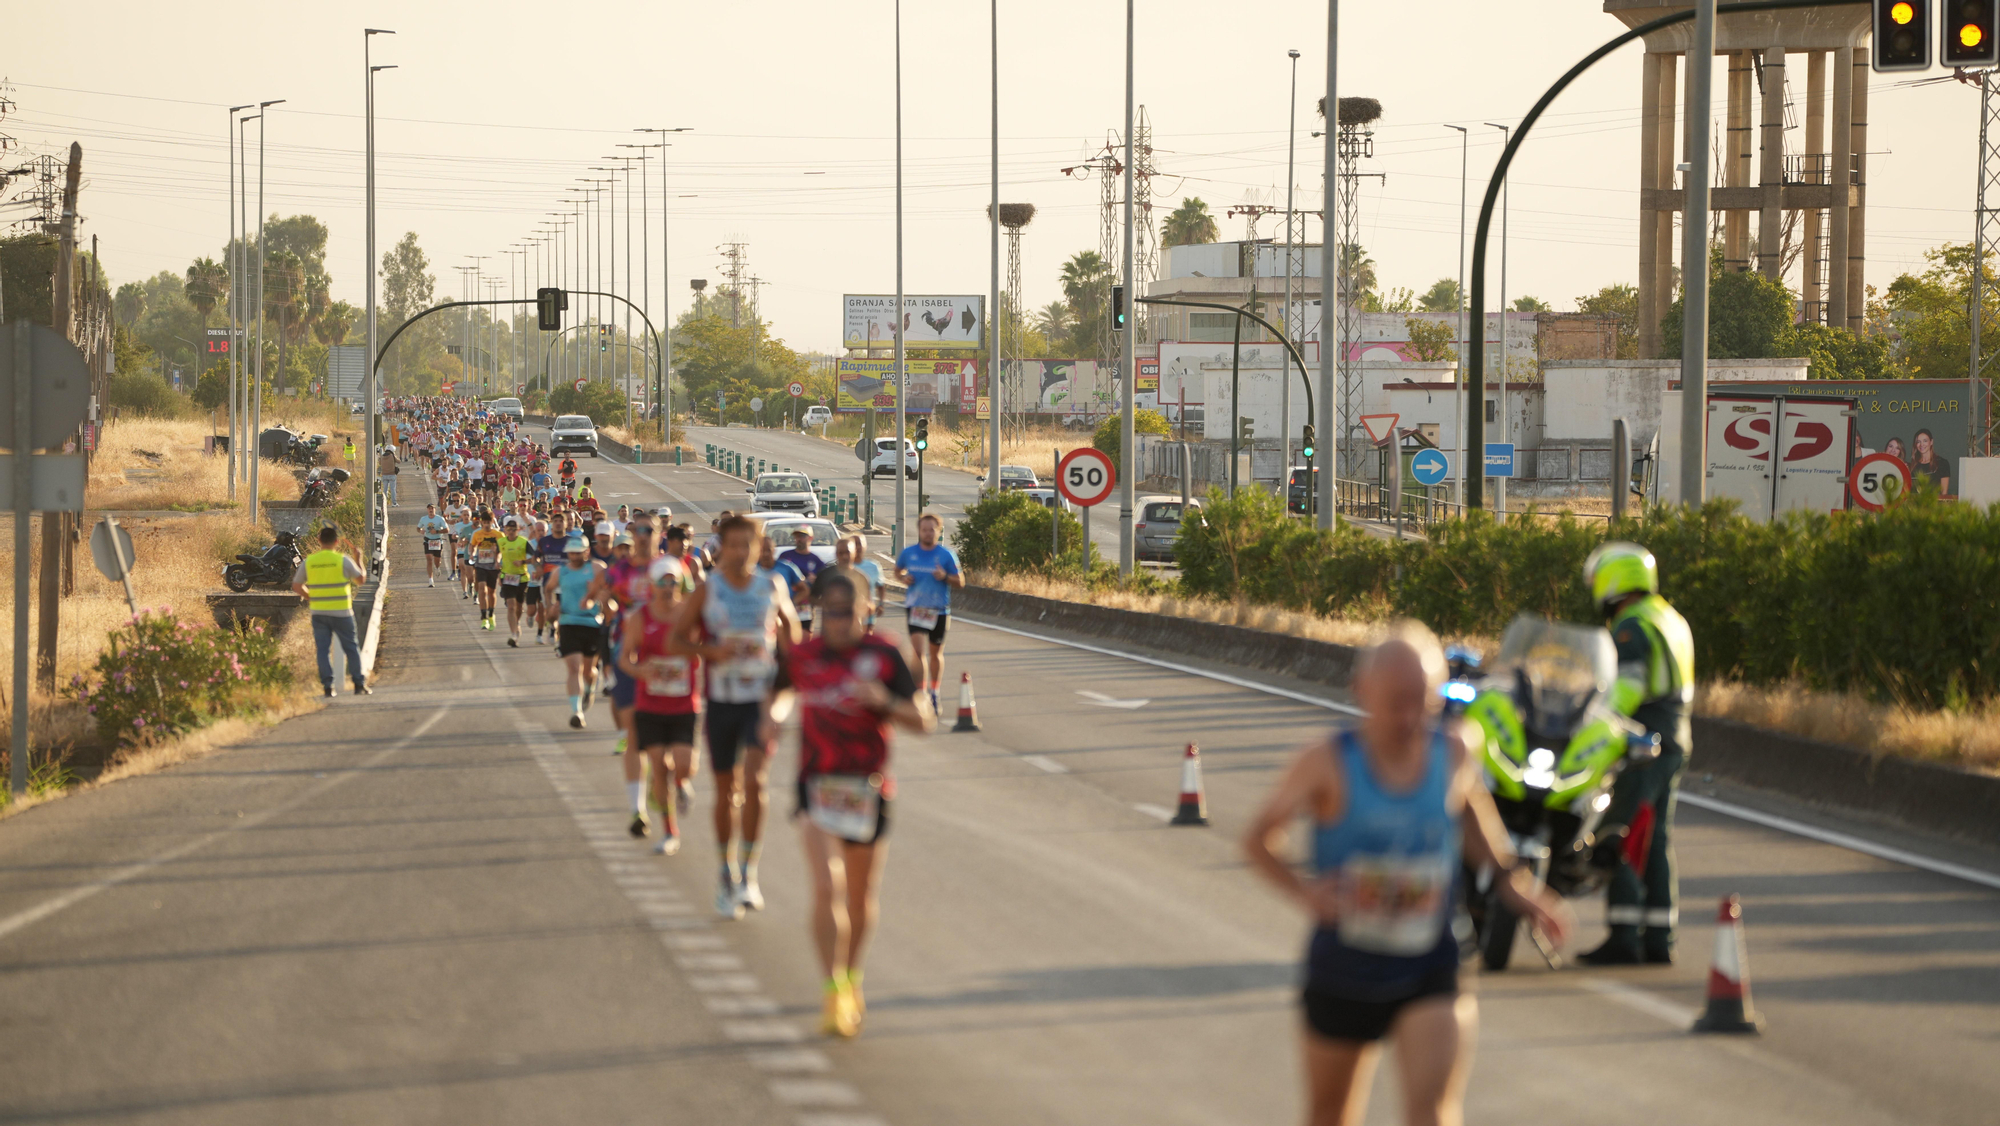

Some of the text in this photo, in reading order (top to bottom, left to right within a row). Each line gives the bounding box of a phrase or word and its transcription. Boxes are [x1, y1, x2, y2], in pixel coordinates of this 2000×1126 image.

[849, 299, 884, 307] GRANJA
[921, 299, 953, 307] ISABEL
[970, 387, 974, 395] 3
[1870, 400, 1882, 413] &
[1888, 400, 1959, 413] CAPILAR
[1069, 467, 1102, 487] 50
[1863, 473, 1898, 493] 50
